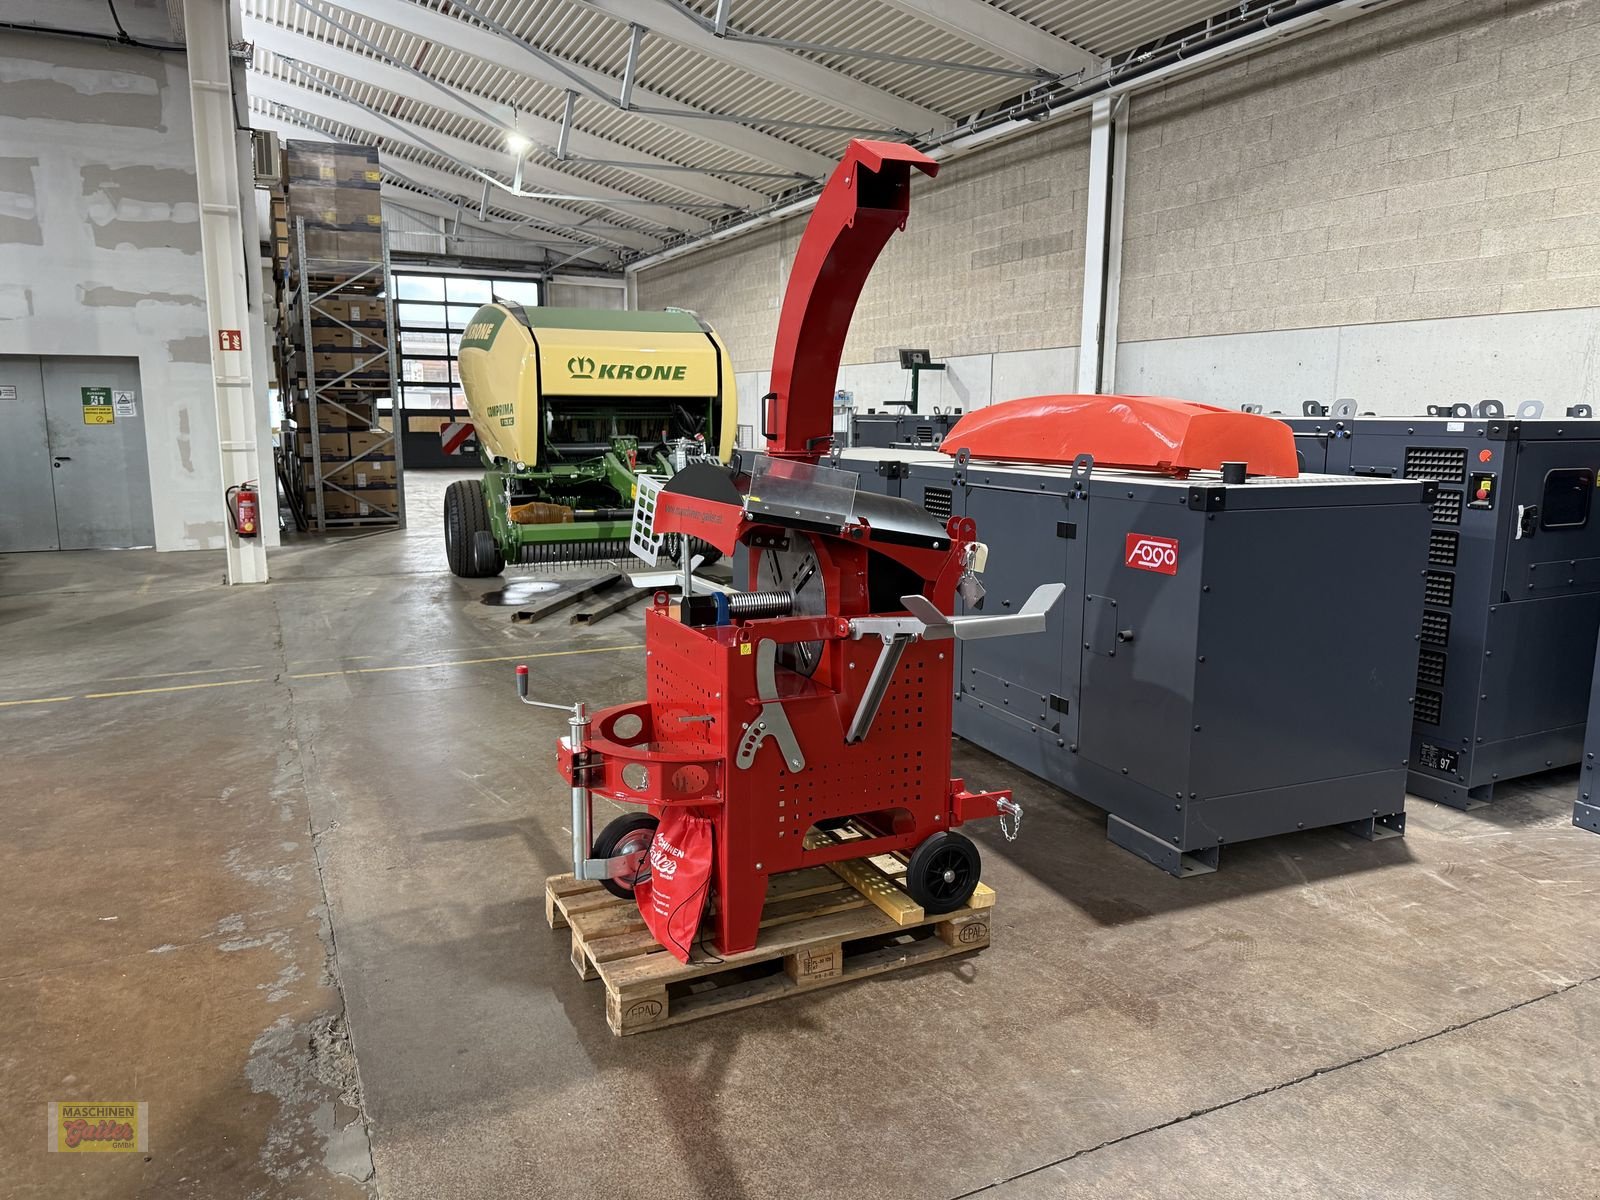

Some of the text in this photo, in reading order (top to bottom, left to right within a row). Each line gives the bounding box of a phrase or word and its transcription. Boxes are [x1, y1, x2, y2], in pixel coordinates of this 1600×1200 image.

[598, 364, 687, 381] KRONE
[486, 403, 514, 418] COMPRIMA
[1440, 757, 1450, 770] 97
[631, 1003, 657, 1018] EPAL
